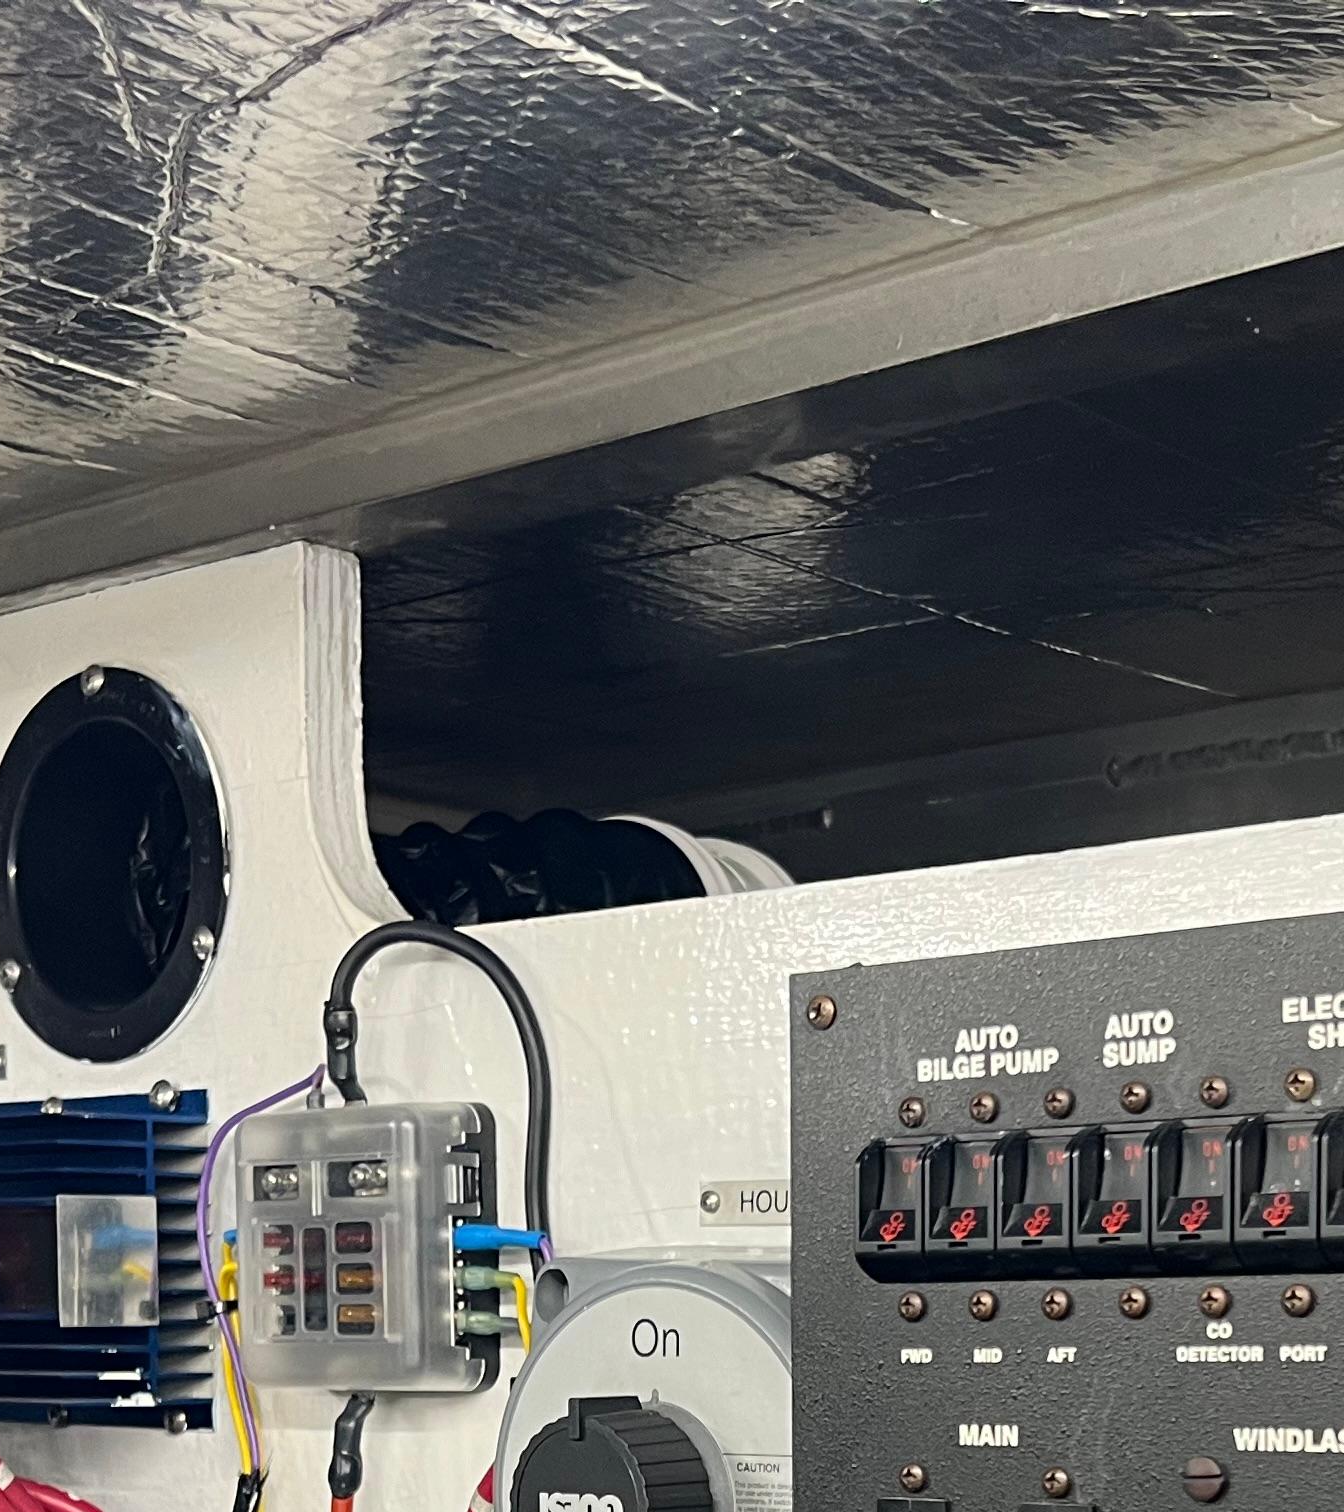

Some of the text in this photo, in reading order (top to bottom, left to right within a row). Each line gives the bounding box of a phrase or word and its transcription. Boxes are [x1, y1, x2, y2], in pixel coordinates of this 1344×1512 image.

[1105, 1010, 1173, 1039] AUTO
[955, 1025, 1018, 1052] AUTO
[1103, 1038, 1176, 1067] SUMP
[918, 1048, 1059, 1082] BILGE PUMP
[1102, 1213, 1130, 1228] OFF
[1180, 1210, 1211, 1225] OFF
[1263, 1205, 1293, 1221] OFF
[880, 1221, 906, 1235] OFF
[950, 1220, 976, 1234] OFF
[1024, 1217, 1051, 1231] OFF
[632, 1319, 680, 1357] On
[1207, 1322, 1232, 1339] CO
[901, 1349, 932, 1363] FWD
[974, 1348, 1002, 1363] MID
[1047, 1347, 1077, 1363] AFT
[1176, 1346, 1263, 1362] DETECTOR
[1280, 1344, 1327, 1362] PORT
[959, 1424, 1018, 1446] MAIN
[737, 1462, 780, 1473] CAUTION
